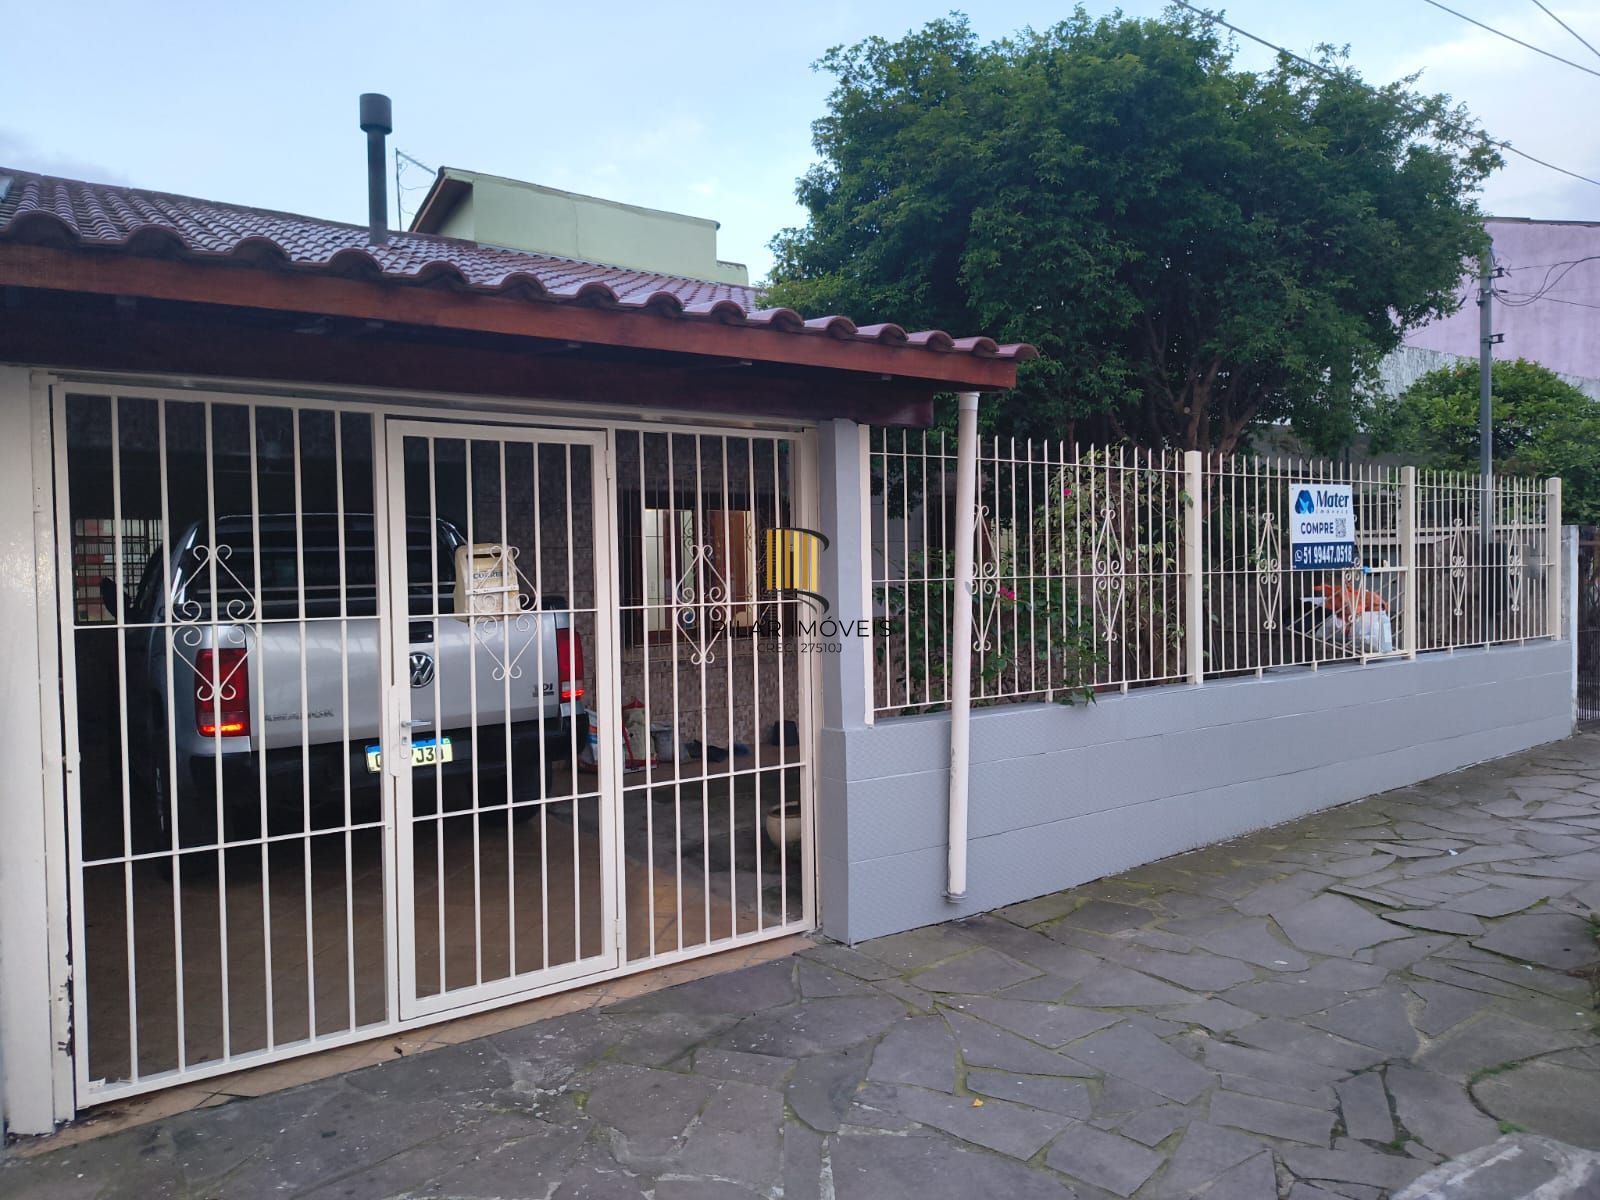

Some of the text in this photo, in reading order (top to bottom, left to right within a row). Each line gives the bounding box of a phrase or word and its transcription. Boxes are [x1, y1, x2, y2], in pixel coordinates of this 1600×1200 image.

[1316, 490, 1350, 508] Mater
[1300, 522, 1334, 535] COMPRE
[1303, 546, 1312, 565] 51
